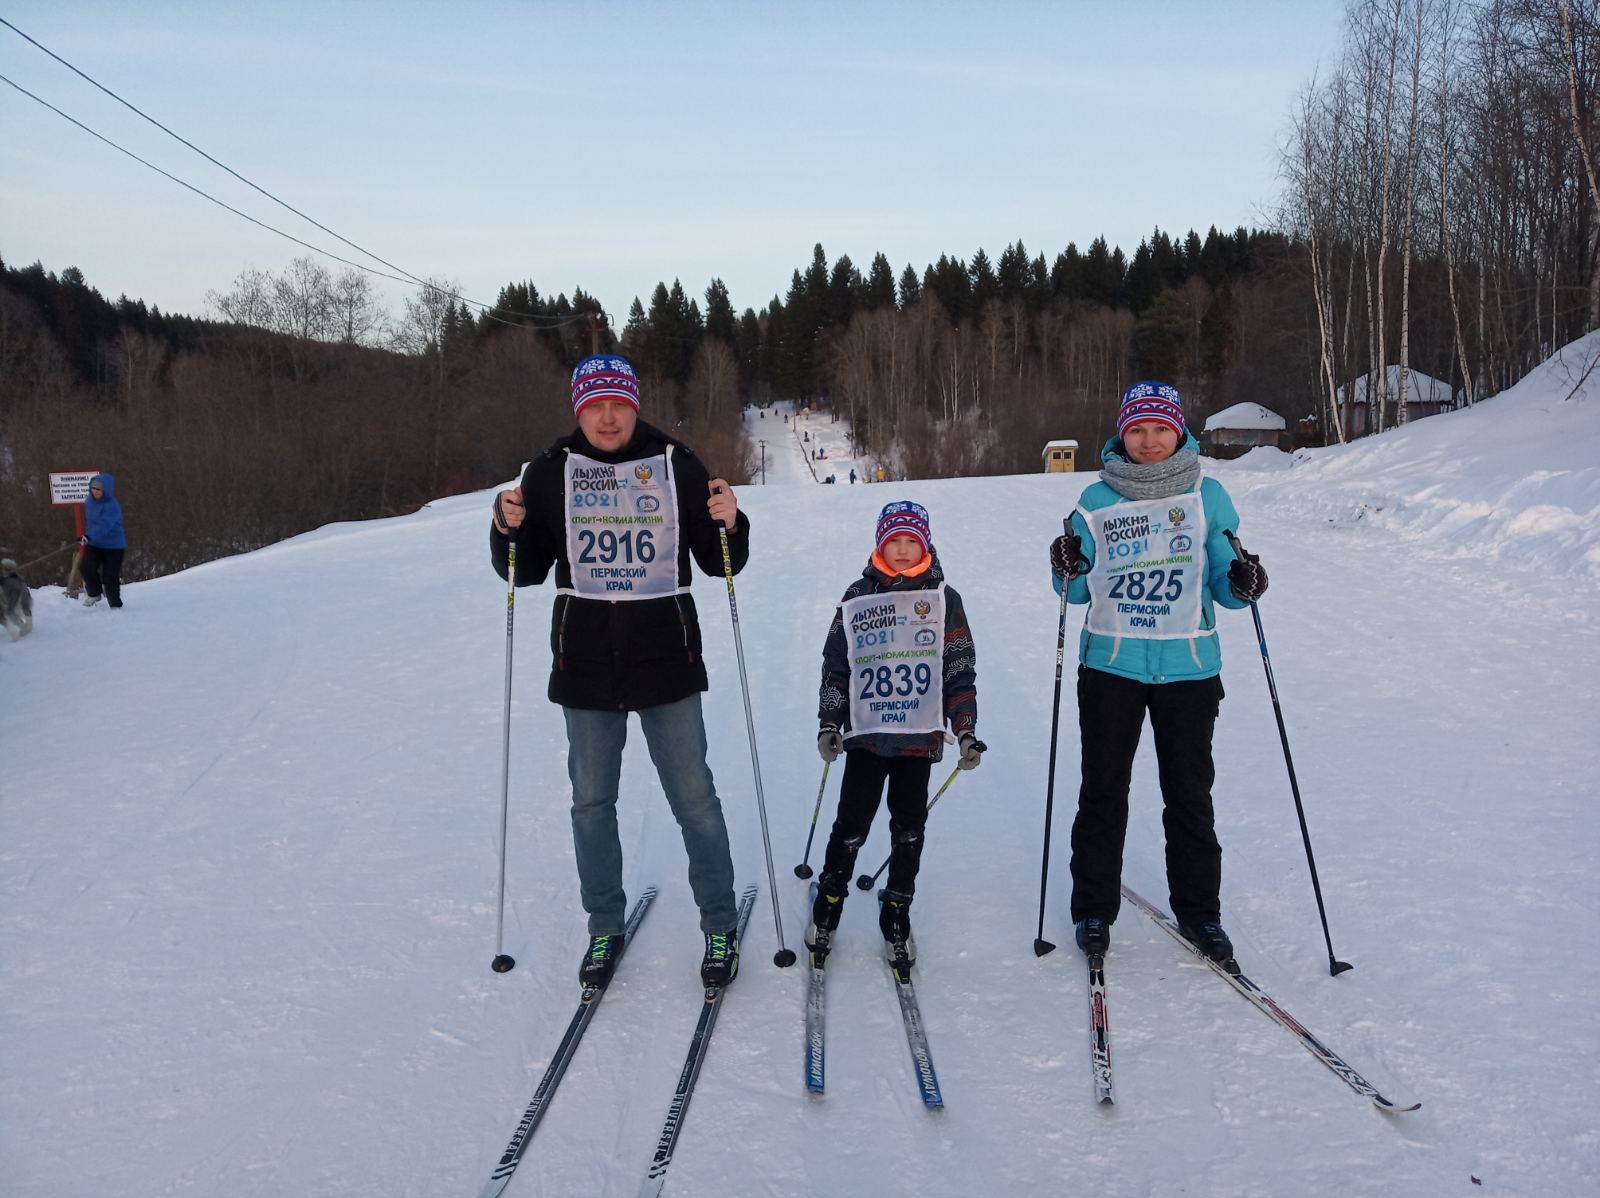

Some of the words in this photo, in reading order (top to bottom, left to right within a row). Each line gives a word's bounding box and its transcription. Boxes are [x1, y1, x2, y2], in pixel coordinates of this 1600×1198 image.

[572, 466, 616, 480] ЛЫЖНЯ
[573, 479, 619, 492] РОССИИ
[573, 492, 618, 507] 2021
[1103, 514, 1149, 534] ЛЫЖНЯ
[1105, 524, 1150, 545] РОССИИ
[578, 529, 656, 564] 2916
[1108, 539, 1148, 560] 2021
[590, 566, 647, 578] ПЕРМСКИЙ
[606, 580, 633, 591] КРАЙ
[1107, 569, 1184, 602] 2825
[850, 604, 896, 624] ЛЫЖНЯ
[1117, 603, 1171, 616] ПЕРМСКИЙ
[852, 616, 897, 634] РОССИИ
[1130, 616, 1156, 628] КРАЙ
[856, 630, 894, 649] 2021
[859, 663, 932, 700] 2839
[869, 698, 920, 712] ПЕРМСКИЙ
[881, 712, 906, 723] КРАЙ
[811, 1032, 823, 1083] NORDWAY
[916, 1047, 937, 1098] NORDWAY
[502, 1096, 542, 1159] UNIVERSAL
[656, 1093, 685, 1156] UNIVERSAL
